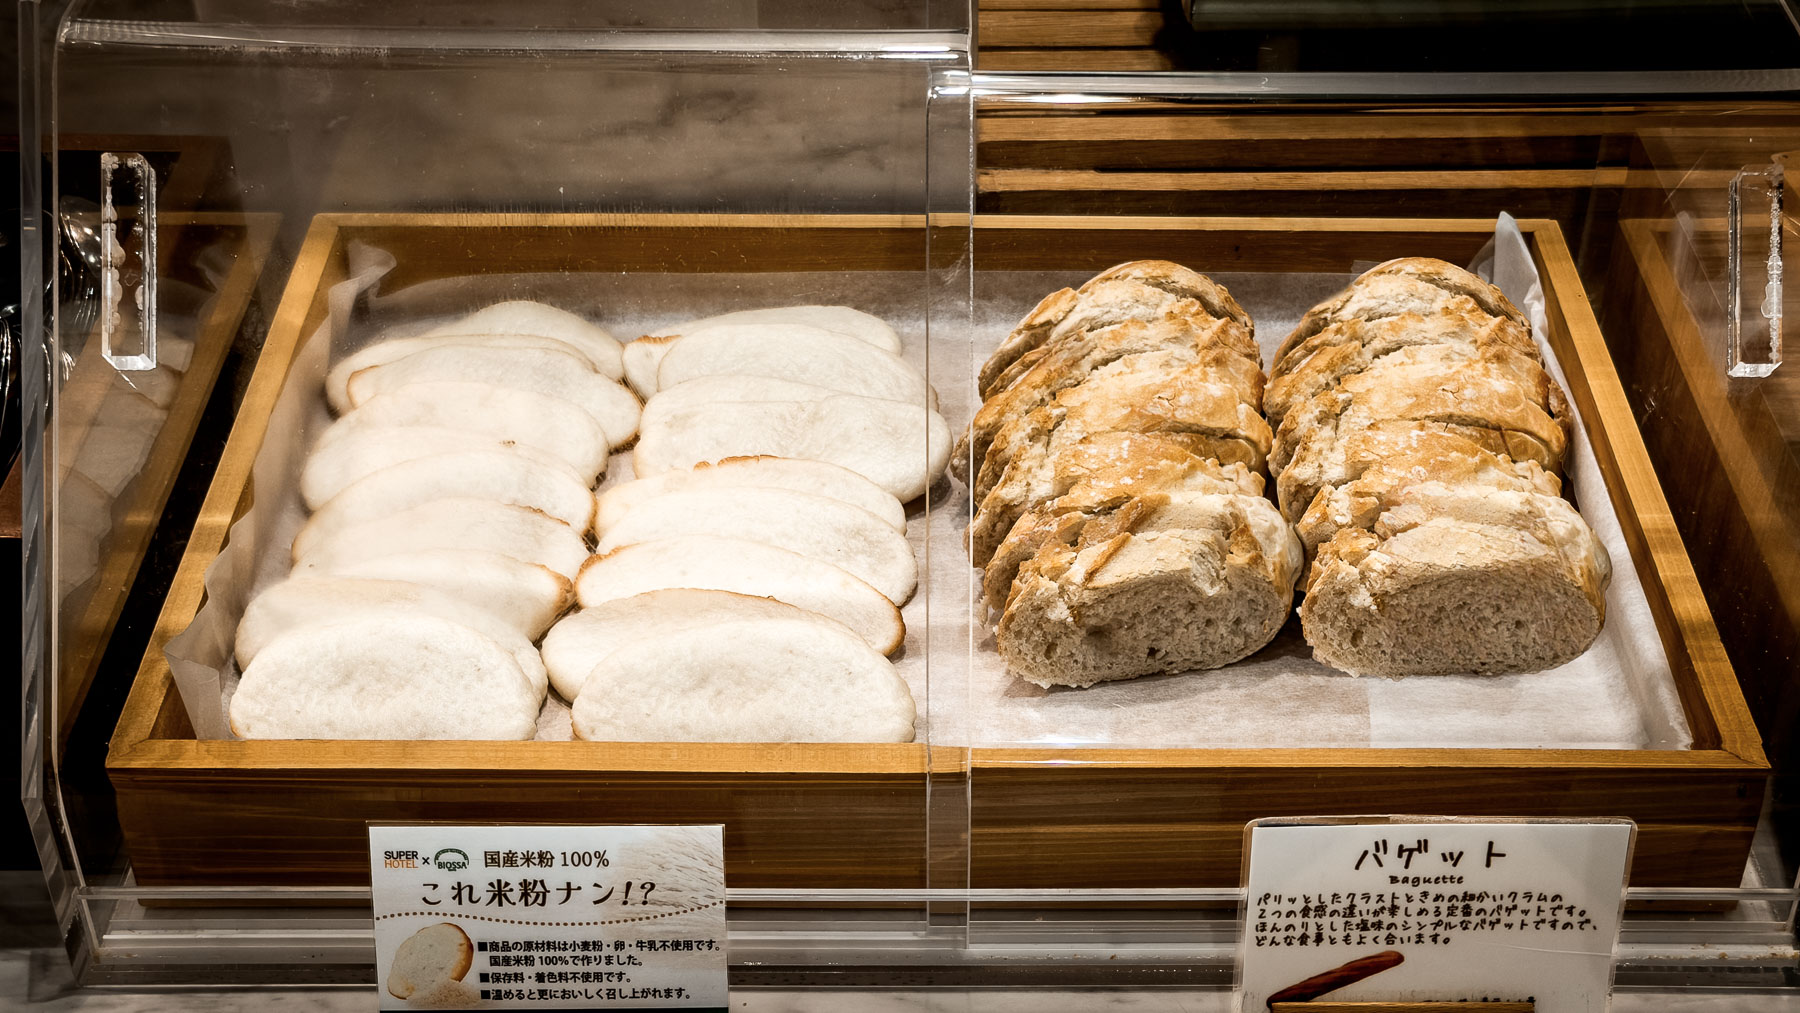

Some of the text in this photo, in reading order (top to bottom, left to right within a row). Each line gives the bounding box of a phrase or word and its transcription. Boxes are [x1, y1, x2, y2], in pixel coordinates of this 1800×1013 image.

[384, 850, 419, 860] SUPER
[484, 850, 555, 868] 国産米粉
[560, 849, 610, 868] 100%
[1354, 838, 1507, 871] バゲット
[384, 860, 419, 869] HOTEL
[437, 861, 468, 870] BIOSSA
[1388, 874, 1465, 888] Baguette
